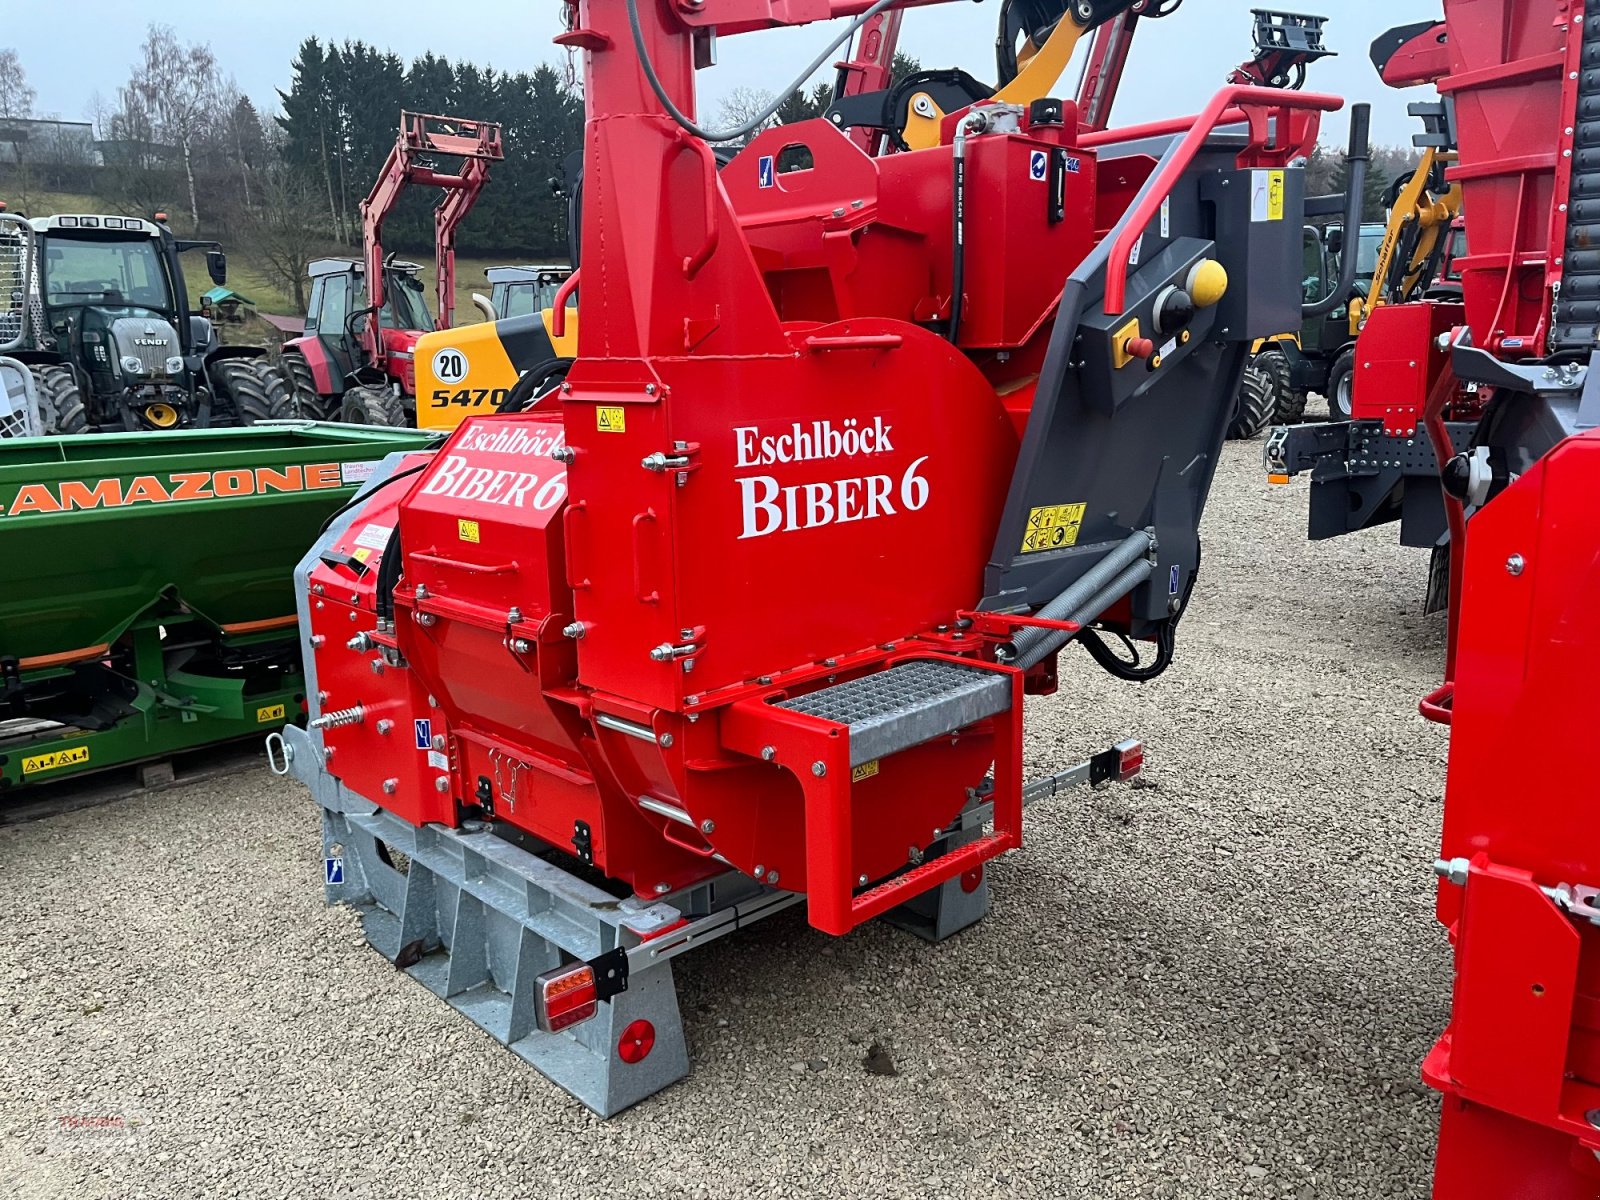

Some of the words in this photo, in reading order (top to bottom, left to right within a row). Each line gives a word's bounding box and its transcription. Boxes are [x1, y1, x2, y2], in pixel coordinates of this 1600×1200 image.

[134, 338, 168, 346] FENDT
[439, 355, 462, 378] 20
[733, 416, 894, 467] Eschlböck
[8, 462, 341, 516] AMAZONE
[420, 455, 538, 508] BIBER
[532, 471, 567, 511] 6
[734, 474, 898, 539] BIBER
[900, 455, 930, 511] 6
